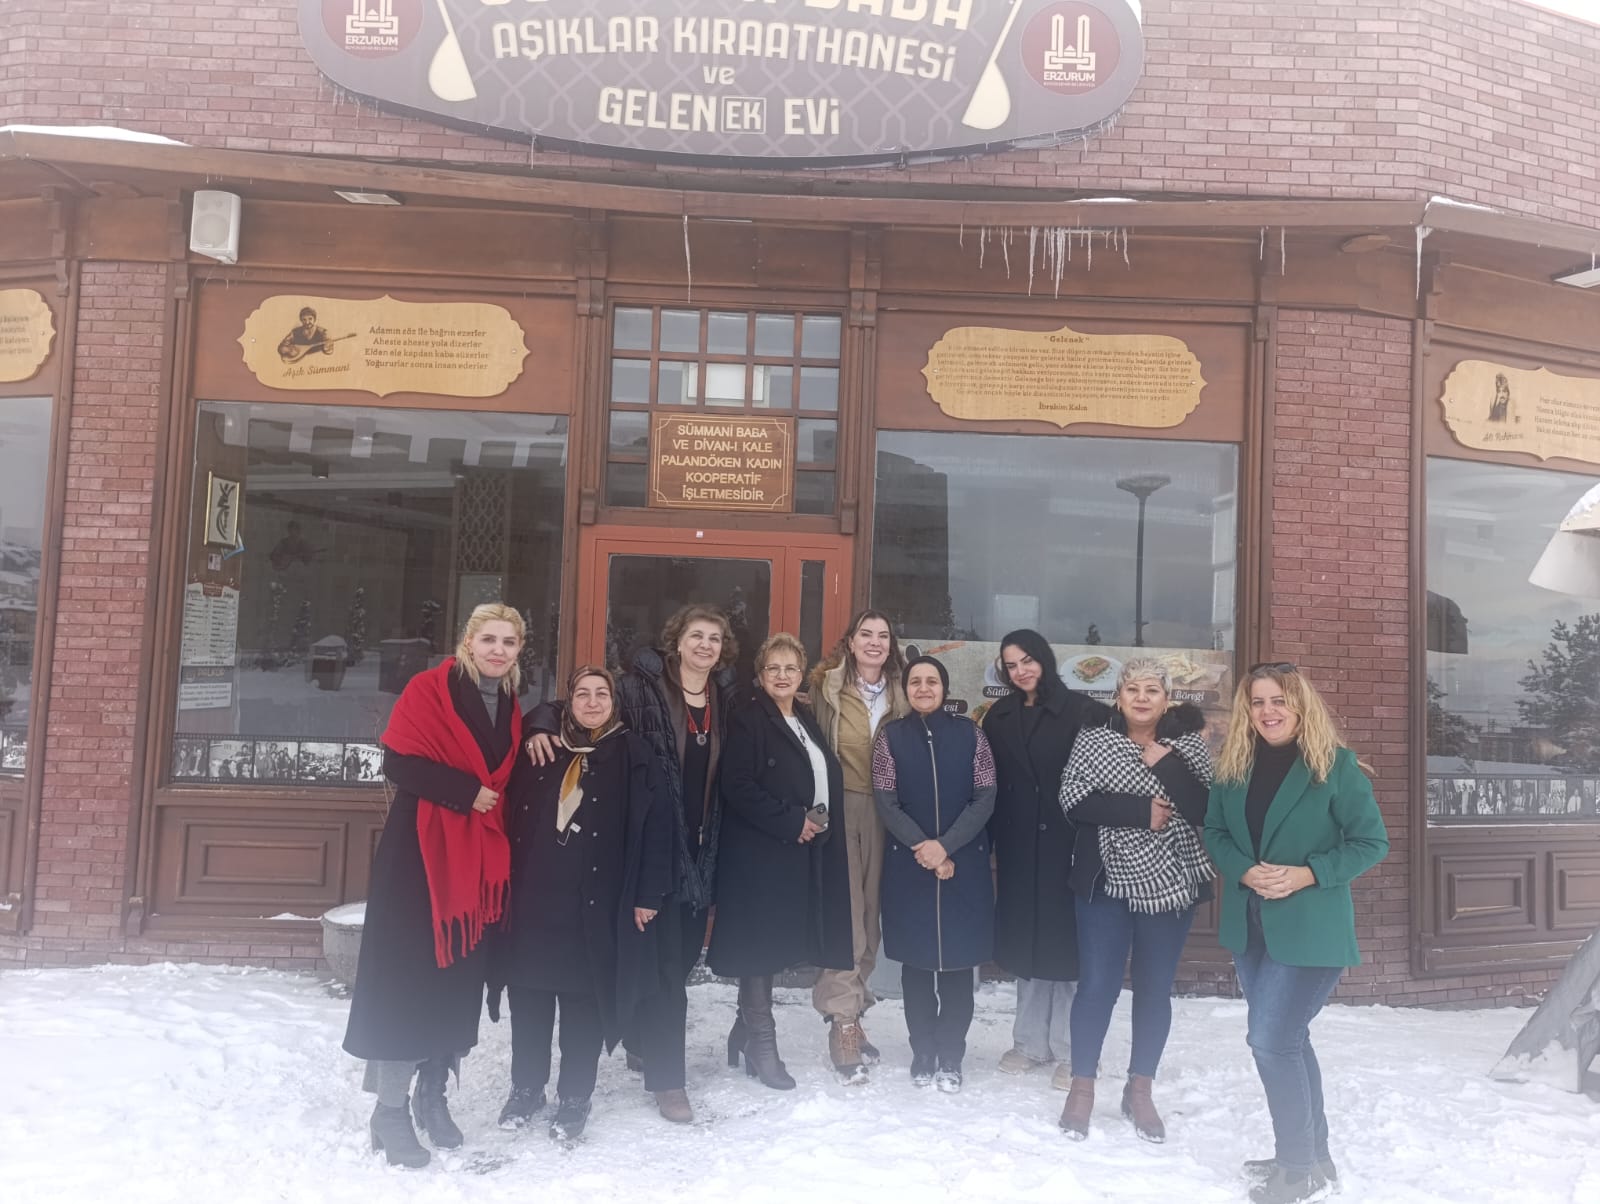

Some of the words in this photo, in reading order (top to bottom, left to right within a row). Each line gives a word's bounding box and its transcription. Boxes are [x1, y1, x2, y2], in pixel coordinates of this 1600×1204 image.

[345, 35, 399, 46] ERZURUM
[492, 16, 659, 60] AŞIKLAR
[703, 65, 736, 85] ve
[1043, 71, 1096, 82] ERZURUM
[677, 422, 733, 438] SÜMMANİ
[736, 426, 768, 438] BABA
[673, 439, 689, 450] VE
[694, 438, 738, 452] DİVAN-I
[742, 441, 773, 453] KALE
[661, 454, 741, 468] PALANDÖKEN
[746, 458, 782, 469] KADIN
[686, 471, 762, 485] KOOPERATİF
[682, 484, 764, 501] İŞLETMESİDİR
